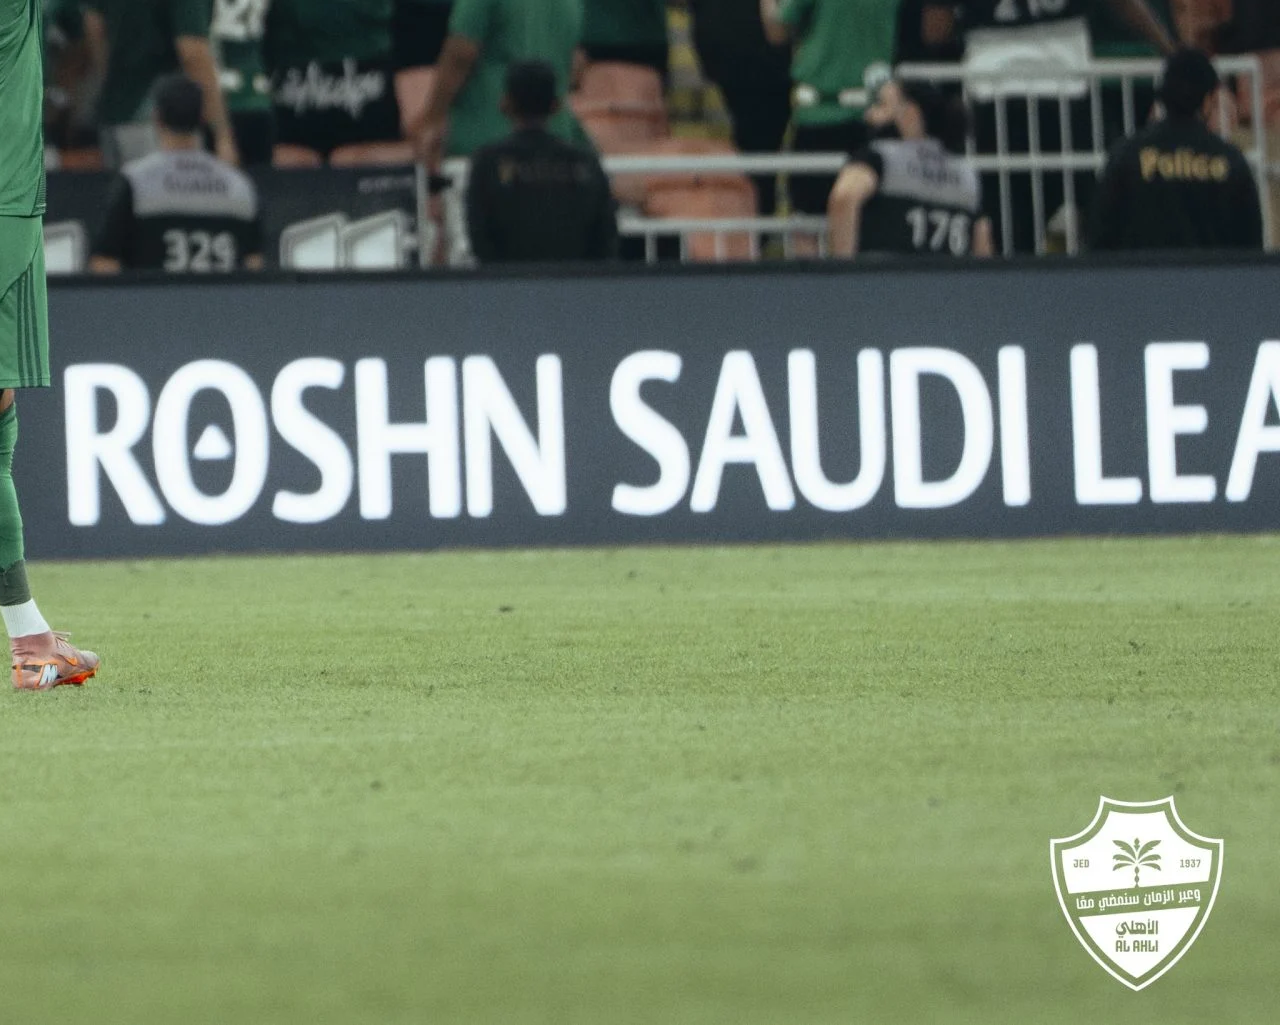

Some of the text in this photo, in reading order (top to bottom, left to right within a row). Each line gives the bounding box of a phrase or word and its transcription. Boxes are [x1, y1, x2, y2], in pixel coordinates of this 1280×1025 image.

[1139, 146, 1231, 182] Police
[162, 229, 238, 274] 329
[63, 339, 1280, 527] ROSHN SAUDI LEA
